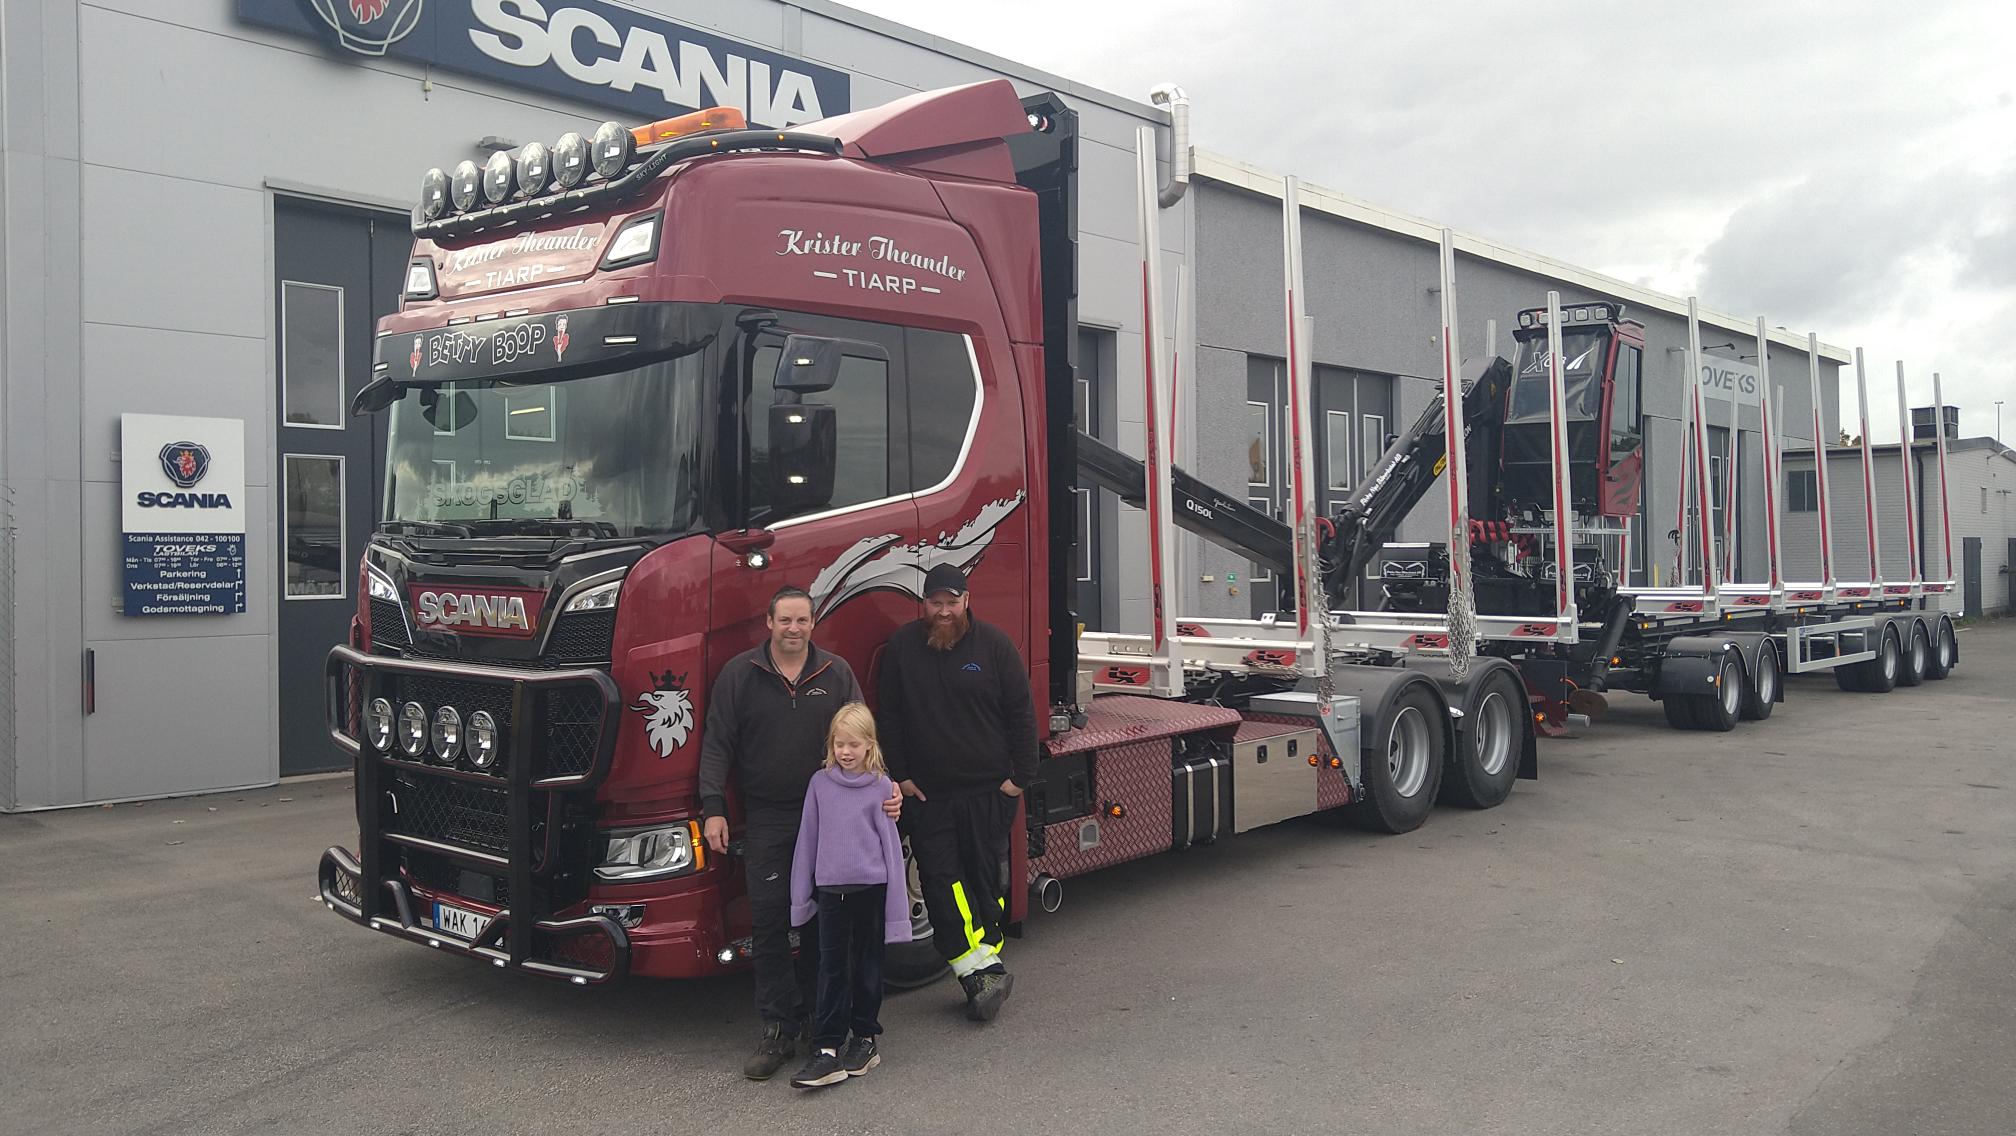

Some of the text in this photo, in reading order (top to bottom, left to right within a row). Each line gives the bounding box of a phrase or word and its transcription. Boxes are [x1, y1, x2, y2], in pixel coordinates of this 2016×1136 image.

[467, 0, 824, 129] SCANIA
[512, 228, 600, 255] Theander
[776, 229, 967, 282] Krister Theander
[485, 264, 544, 288] TIARP
[842, 268, 916, 295] TIARP
[429, 323, 546, 367] BETTY BOOP
[136, 492, 233, 509] SCANIA
[1186, 499, 1214, 520] Q150L
[153, 544, 217, 553] TOVEKS
[155, 535, 194, 543] Assistance
[130, 581, 235, 590] Verkstad/Reservdelar
[160, 570, 207, 579] Parkering
[156, 593, 211, 602] Försäljning
[142, 605, 225, 614] Godsmottagning
[418, 591, 528, 630] SCANIA
[443, 908, 468, 934] WAK
